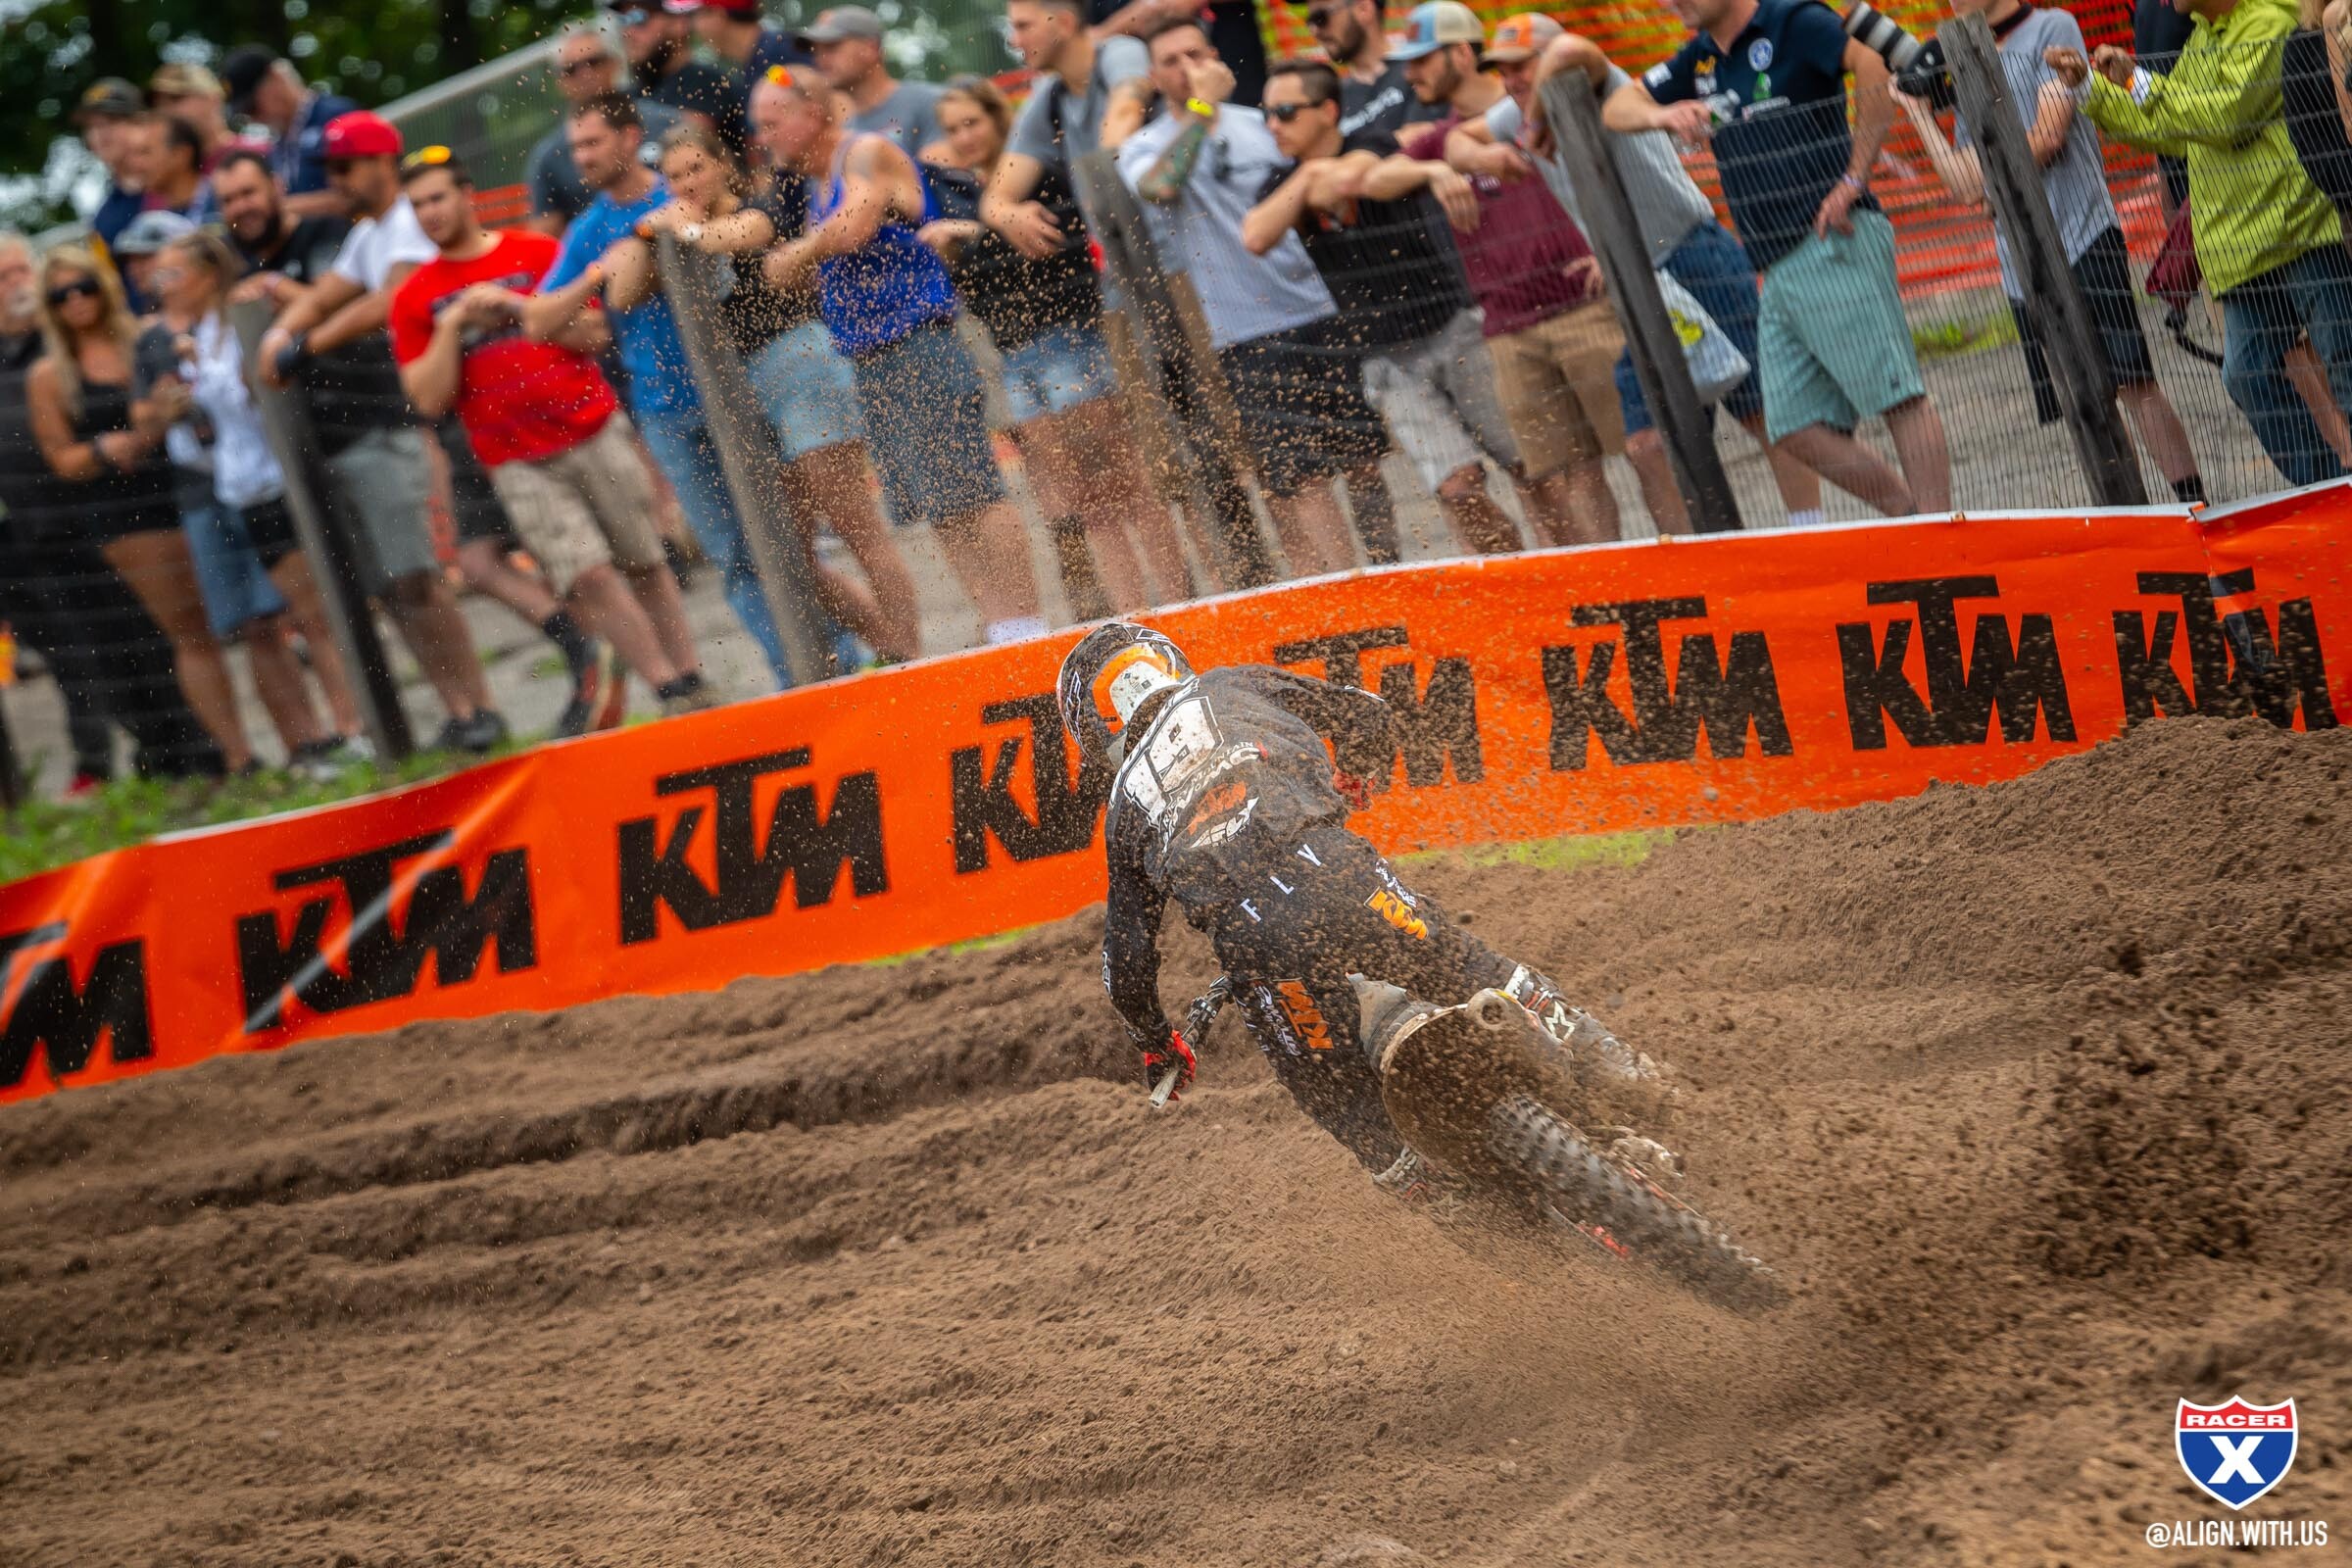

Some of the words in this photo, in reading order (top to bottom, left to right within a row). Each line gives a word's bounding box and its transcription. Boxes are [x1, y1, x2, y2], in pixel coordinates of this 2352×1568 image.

[1273, 625, 1487, 796] TM
[1542, 595, 1793, 771] KTM
[1836, 575, 2077, 751] KTM
[2112, 567, 2340, 732] KTM
[237, 826, 538, 1034] KTM
[618, 746, 890, 947] KTM
[1367, 888, 1429, 941] KTM
[1277, 981, 1334, 1049] KTM
